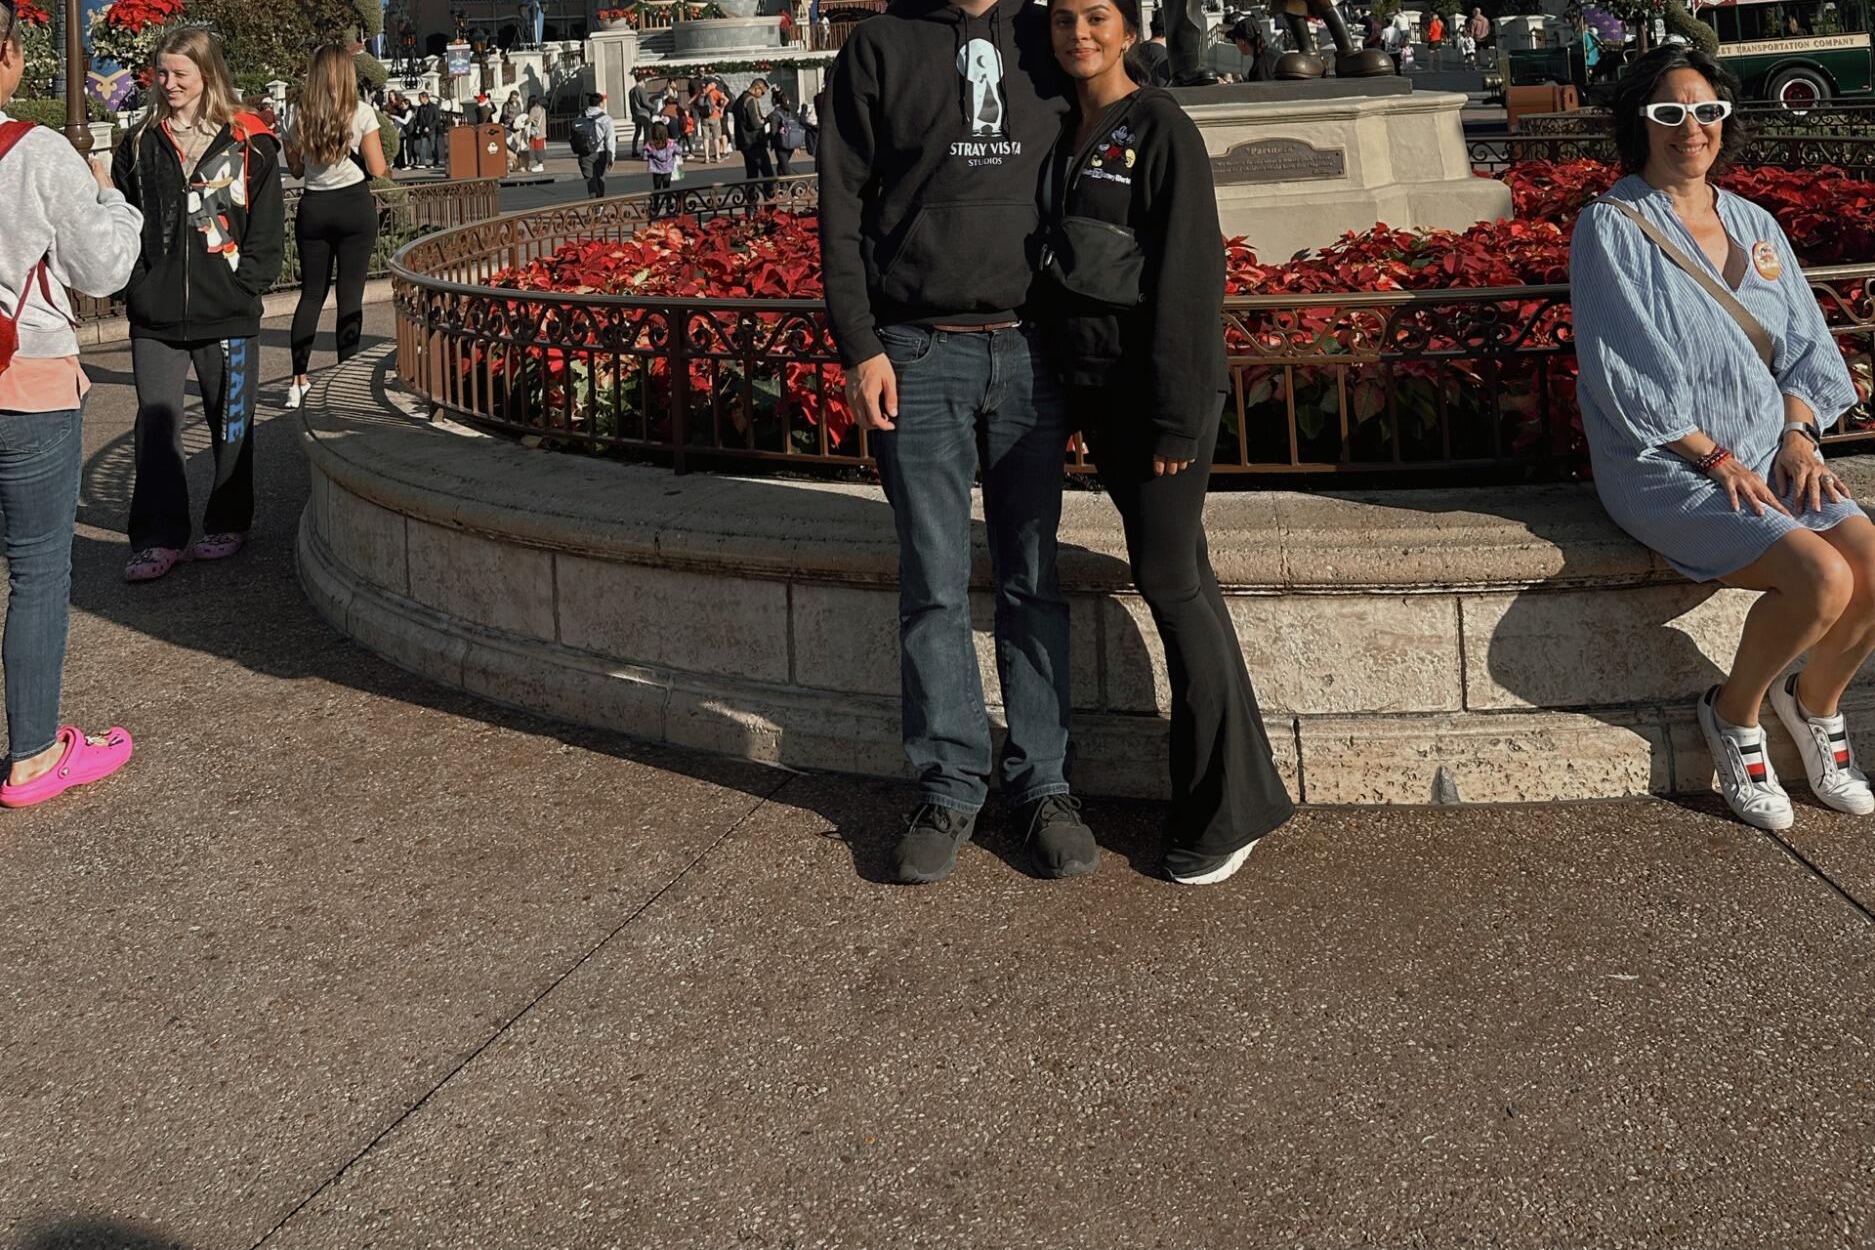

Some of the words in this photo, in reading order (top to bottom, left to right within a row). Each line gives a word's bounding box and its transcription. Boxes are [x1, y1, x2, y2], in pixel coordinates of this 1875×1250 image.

[1717, 46, 1731, 56] ET
[1736, 41, 1810, 54] TRANSPORTATION
[1813, 37, 1855, 48] COMPANY
[949, 142, 987, 156] STRAY
[990, 141, 1021, 155] VISTA
[968, 157, 1002, 167] STUDIOS
